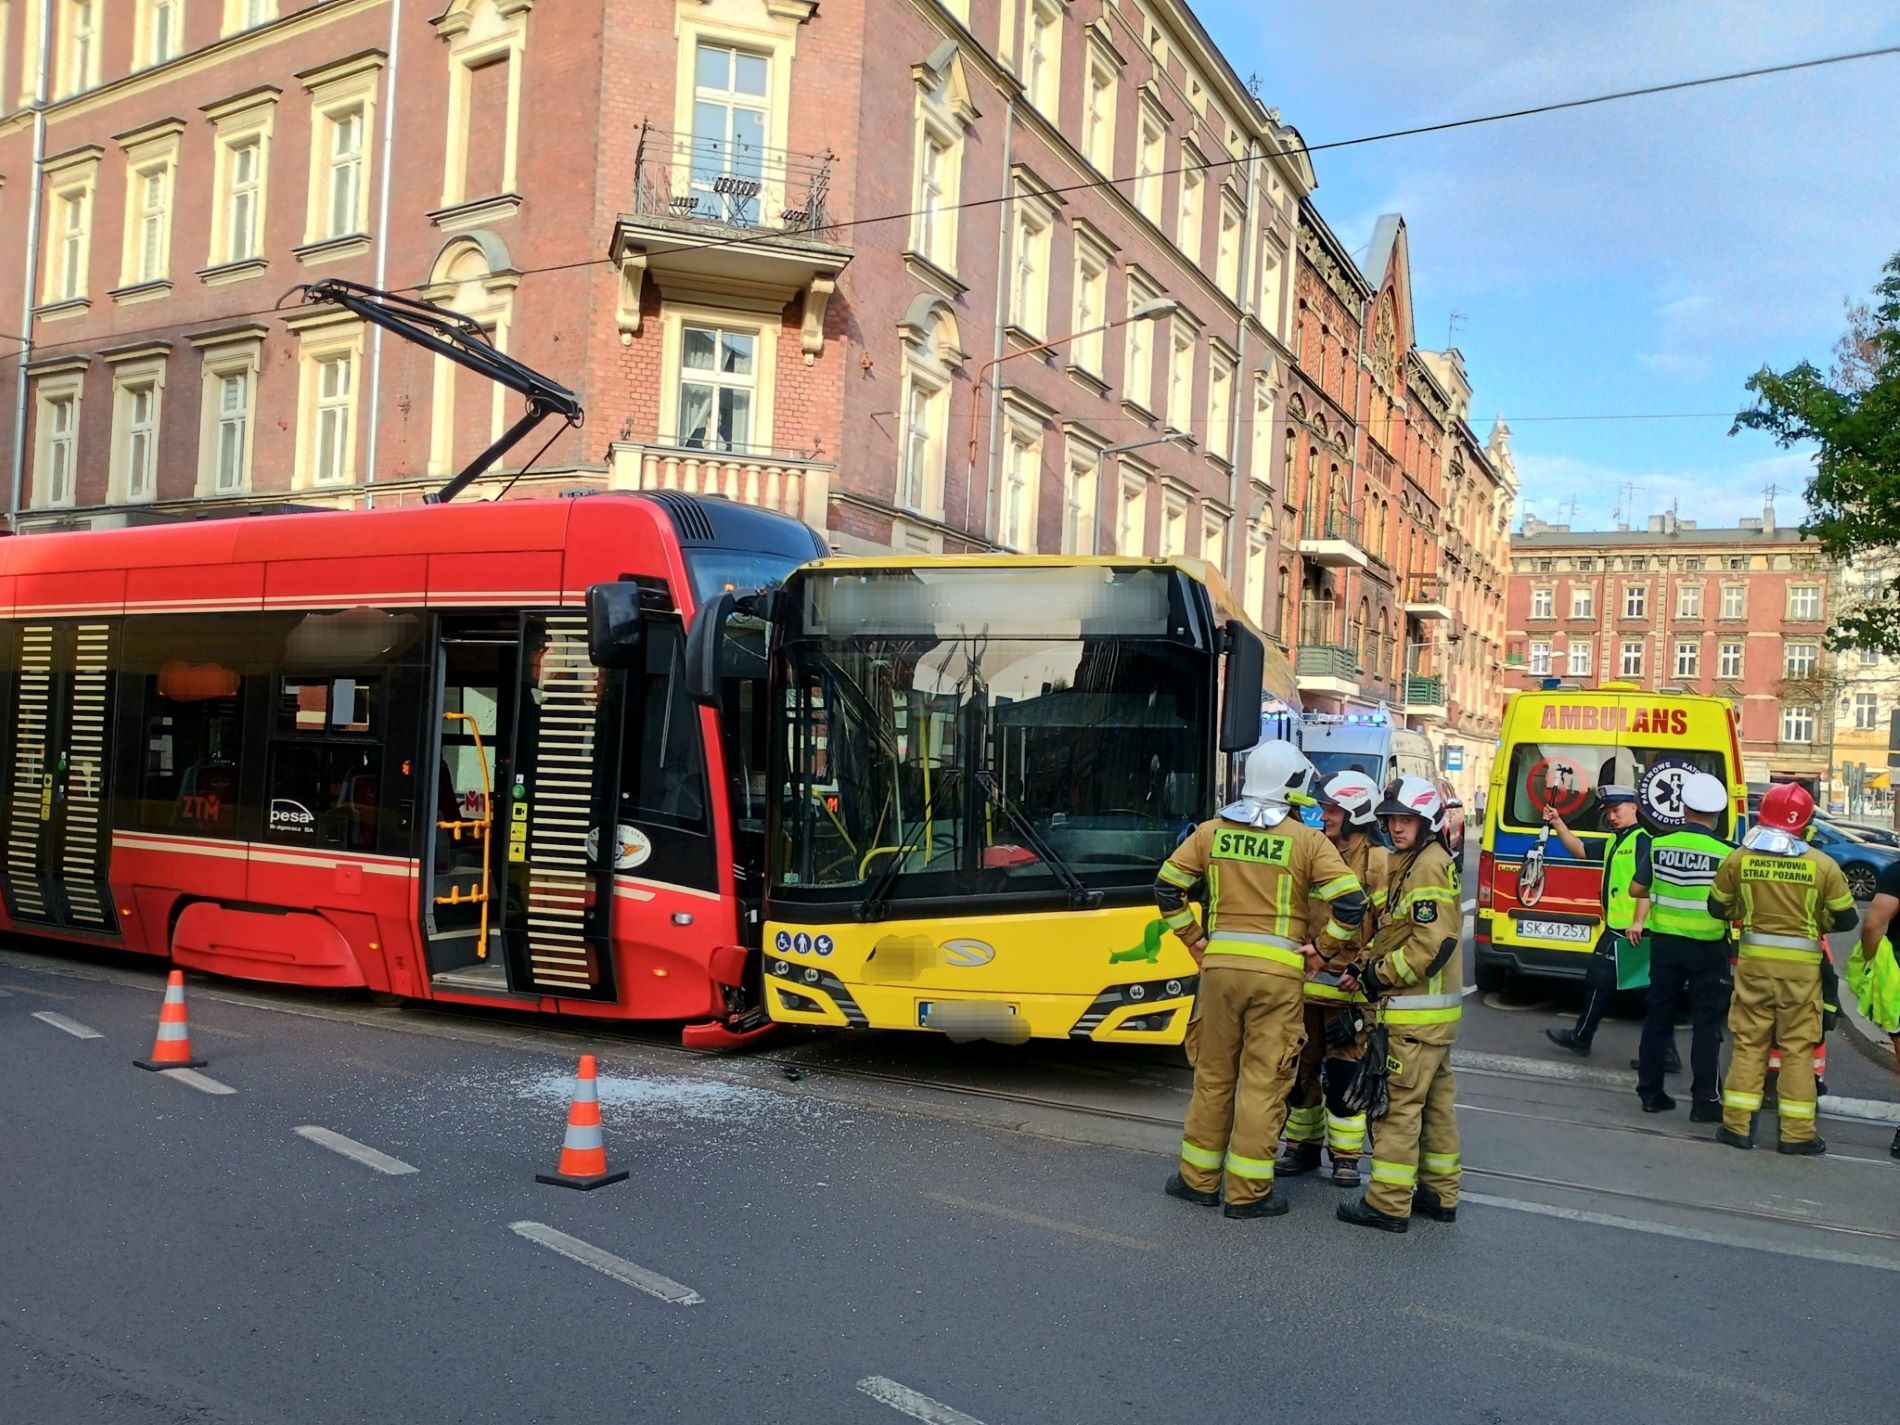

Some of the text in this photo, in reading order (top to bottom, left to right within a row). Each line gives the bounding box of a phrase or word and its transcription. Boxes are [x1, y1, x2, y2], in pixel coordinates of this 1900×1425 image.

[1541, 705, 1688, 735] AMBULANS
[182, 795, 220, 820] ZTM
[270, 810, 309, 823] pesa
[1787, 811, 1798, 824] 3
[1659, 851, 1711, 871] POLICJA
[1526, 922, 1587, 938] SK 612SX
